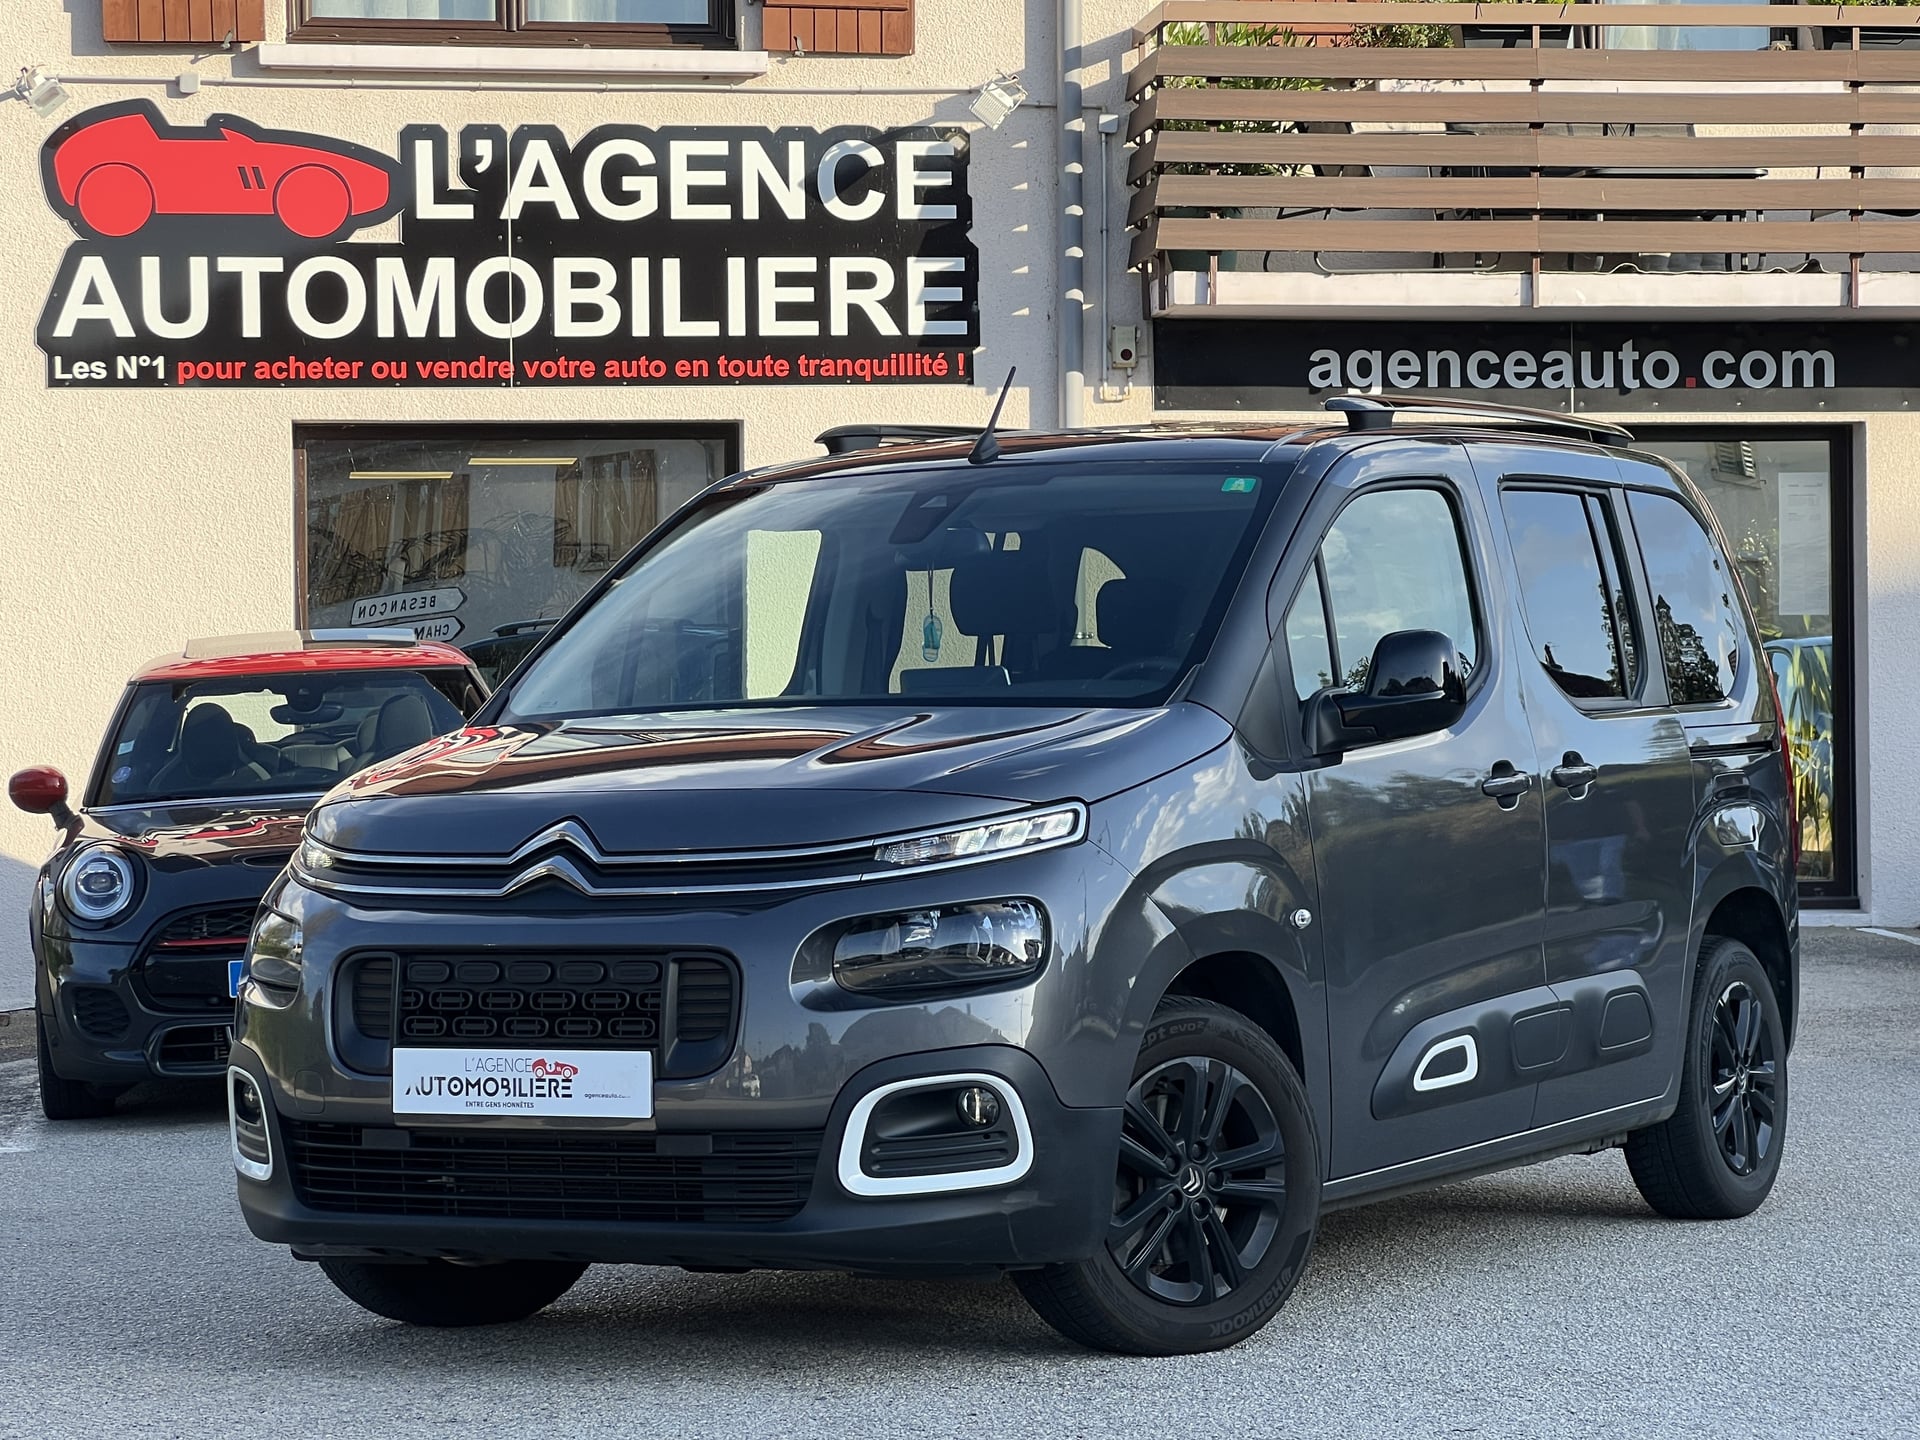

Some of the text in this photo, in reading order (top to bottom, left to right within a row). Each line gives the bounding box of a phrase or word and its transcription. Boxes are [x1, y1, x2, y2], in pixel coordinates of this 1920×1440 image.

[52, 255, 968, 340] AUTOMOBILIERE
[54, 356, 108, 381] Les
[117, 356, 166, 381] N°1
[177, 361, 247, 386] pour
[254, 356, 364, 381] acheter
[371, 361, 408, 381] ou
[416, 356, 515, 381] vendre
[524, 357, 597, 380] votre
[604, 357, 667, 380] auto
[674, 360, 711, 380] en
[718, 356, 790, 379] toute
[798, 353, 948, 383] tranquillité
[1308, 338, 1836, 394] agenceauto.com
[465, 1100, 484, 1108] ENTRE
